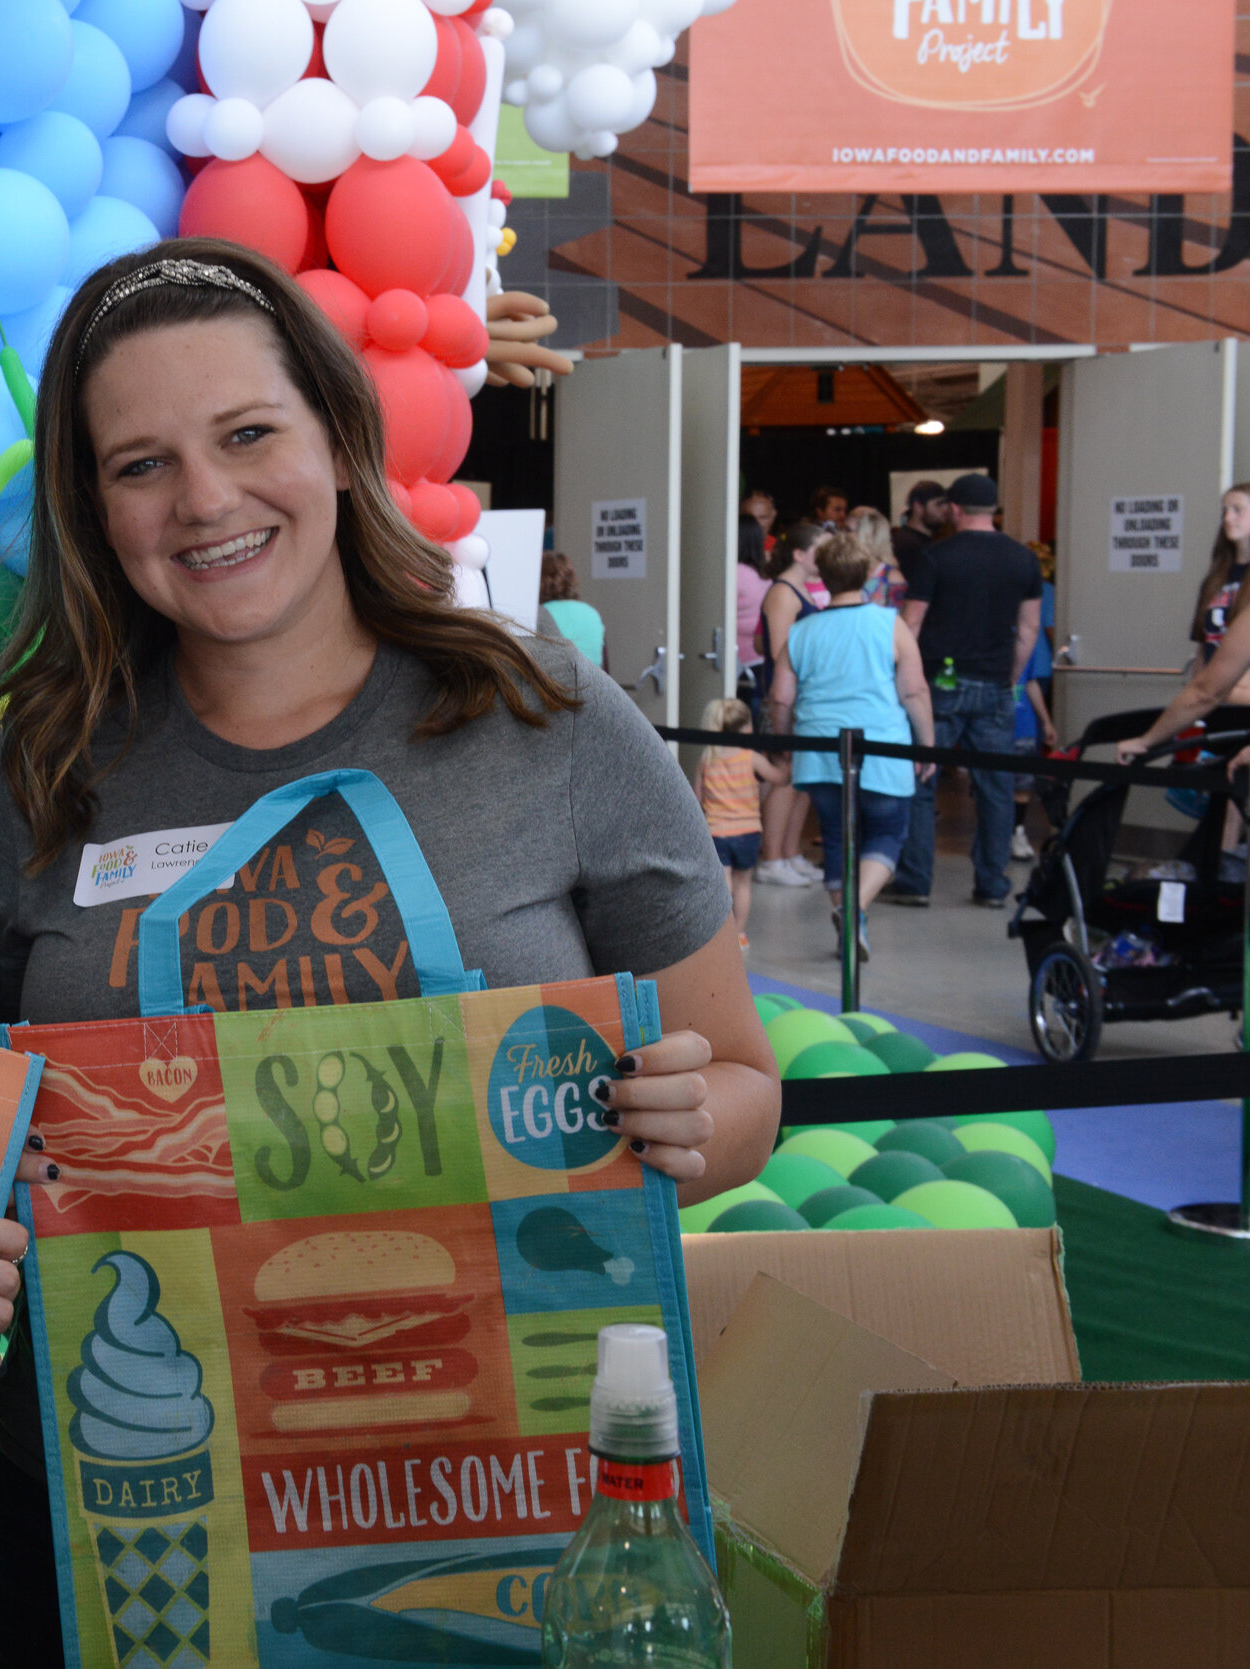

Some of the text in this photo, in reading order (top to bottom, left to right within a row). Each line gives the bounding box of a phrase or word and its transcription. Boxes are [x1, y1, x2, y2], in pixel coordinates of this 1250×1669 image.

[892, 0, 1064, 40] FAMILY
[916, 28, 1011, 73] Project
[831, 147, 1095, 164] IOWAFOODANDFAMILY.COM
[91, 849, 138, 879] FOOD &
[98, 848, 125, 864] IOWA
[154, 839, 209, 856] Catie
[95, 864, 138, 887] FAMILY
[310, 862, 389, 945] &
[187, 940, 409, 1012] AMILY
[147, 1067, 193, 1087] BACON
[506, 1038, 598, 1084] Fresh
[254, 1036, 445, 1191] SOY
[500, 1075, 614, 1144] EGGS
[293, 1358, 443, 1392] BEEF
[92, 1468, 203, 1511] DAIRY
[261, 1449, 552, 1534] WHOLESOME
